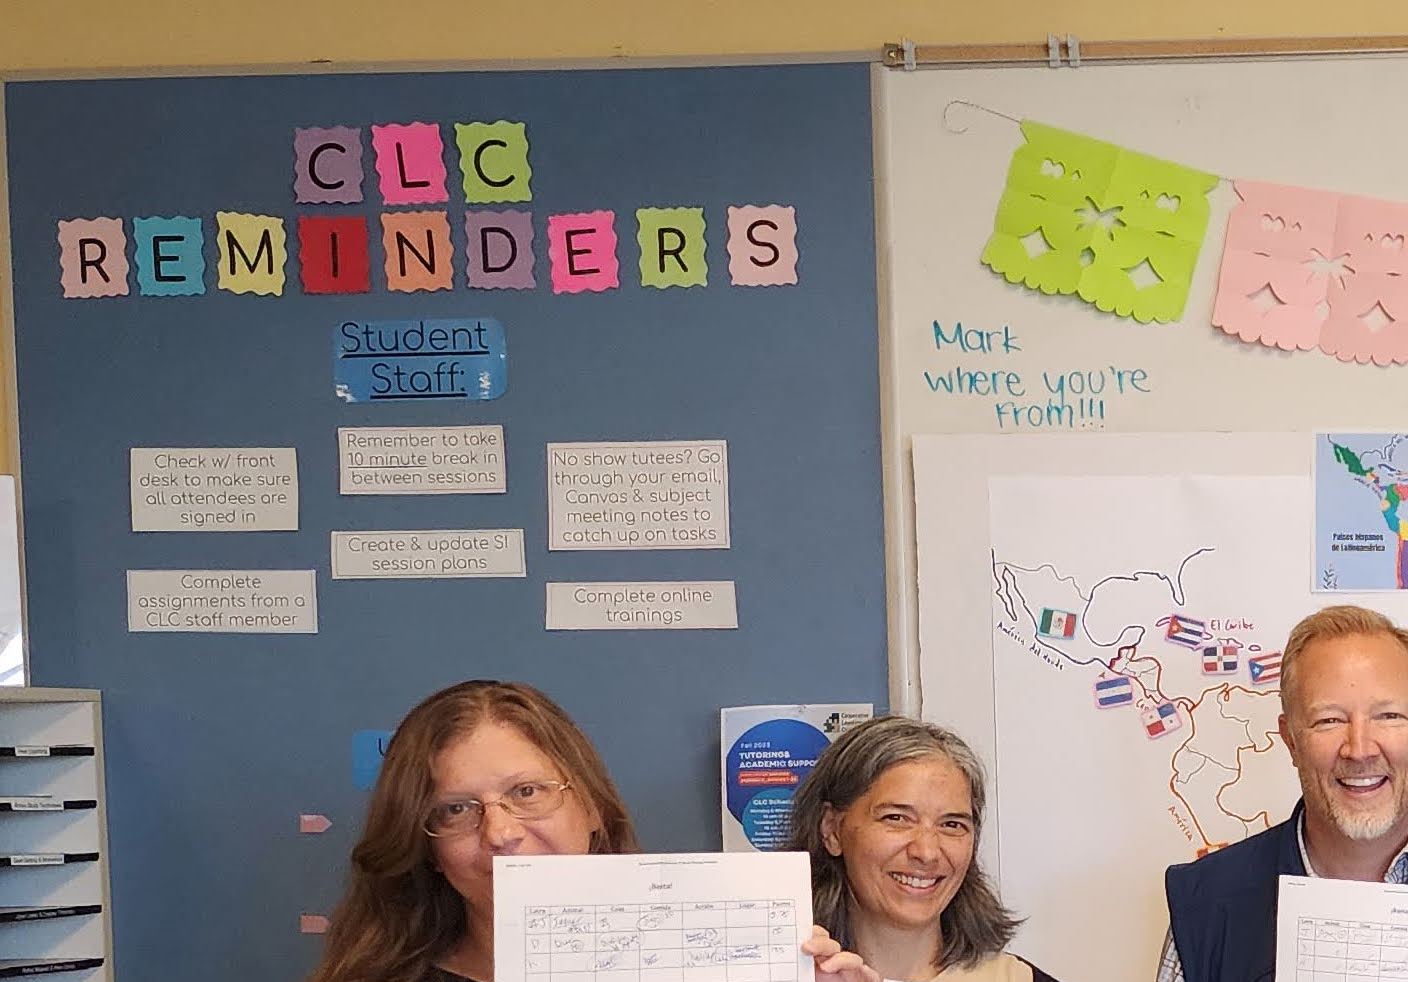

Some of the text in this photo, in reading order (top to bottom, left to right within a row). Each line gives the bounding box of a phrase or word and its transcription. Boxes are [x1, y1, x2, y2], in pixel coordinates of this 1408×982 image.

[308, 139, 516, 190] CLC
[78, 219, 780, 284] REMINDERS
[340, 321, 490, 354] Student
[932, 319, 1023, 354] Mark
[370, 361, 467, 395] Staff:
[923, 366, 1151, 403] where you're
[347, 432, 497, 448] Remember to take
[154, 453, 276, 469] Check w/ front
[348, 451, 497, 466] 10 minute break in
[554, 449, 721, 466] No show tutees? Go
[139, 473, 291, 487] desk to make sure
[352, 470, 497, 485] between sessions
[554, 469, 722, 488] through your email,
[146, 491, 287, 505] all attendees are
[565, 488, 712, 506] Canvas & subject
[180, 510, 256, 526] signed in
[567, 507, 711, 525] meeting notes to
[348, 537, 406, 552] Create
[410, 536, 421, 551] &
[427, 535, 489, 553] update
[563, 526, 717, 545] catch up on tasks
[372, 555, 487, 572] session plans
[181, 574, 262, 591] Complete
[138, 594, 305, 611] assignments from a
[574, 588, 712, 605] Complete online
[146, 612, 299, 627] CLC staff member
[606, 607, 682, 624] trainings
